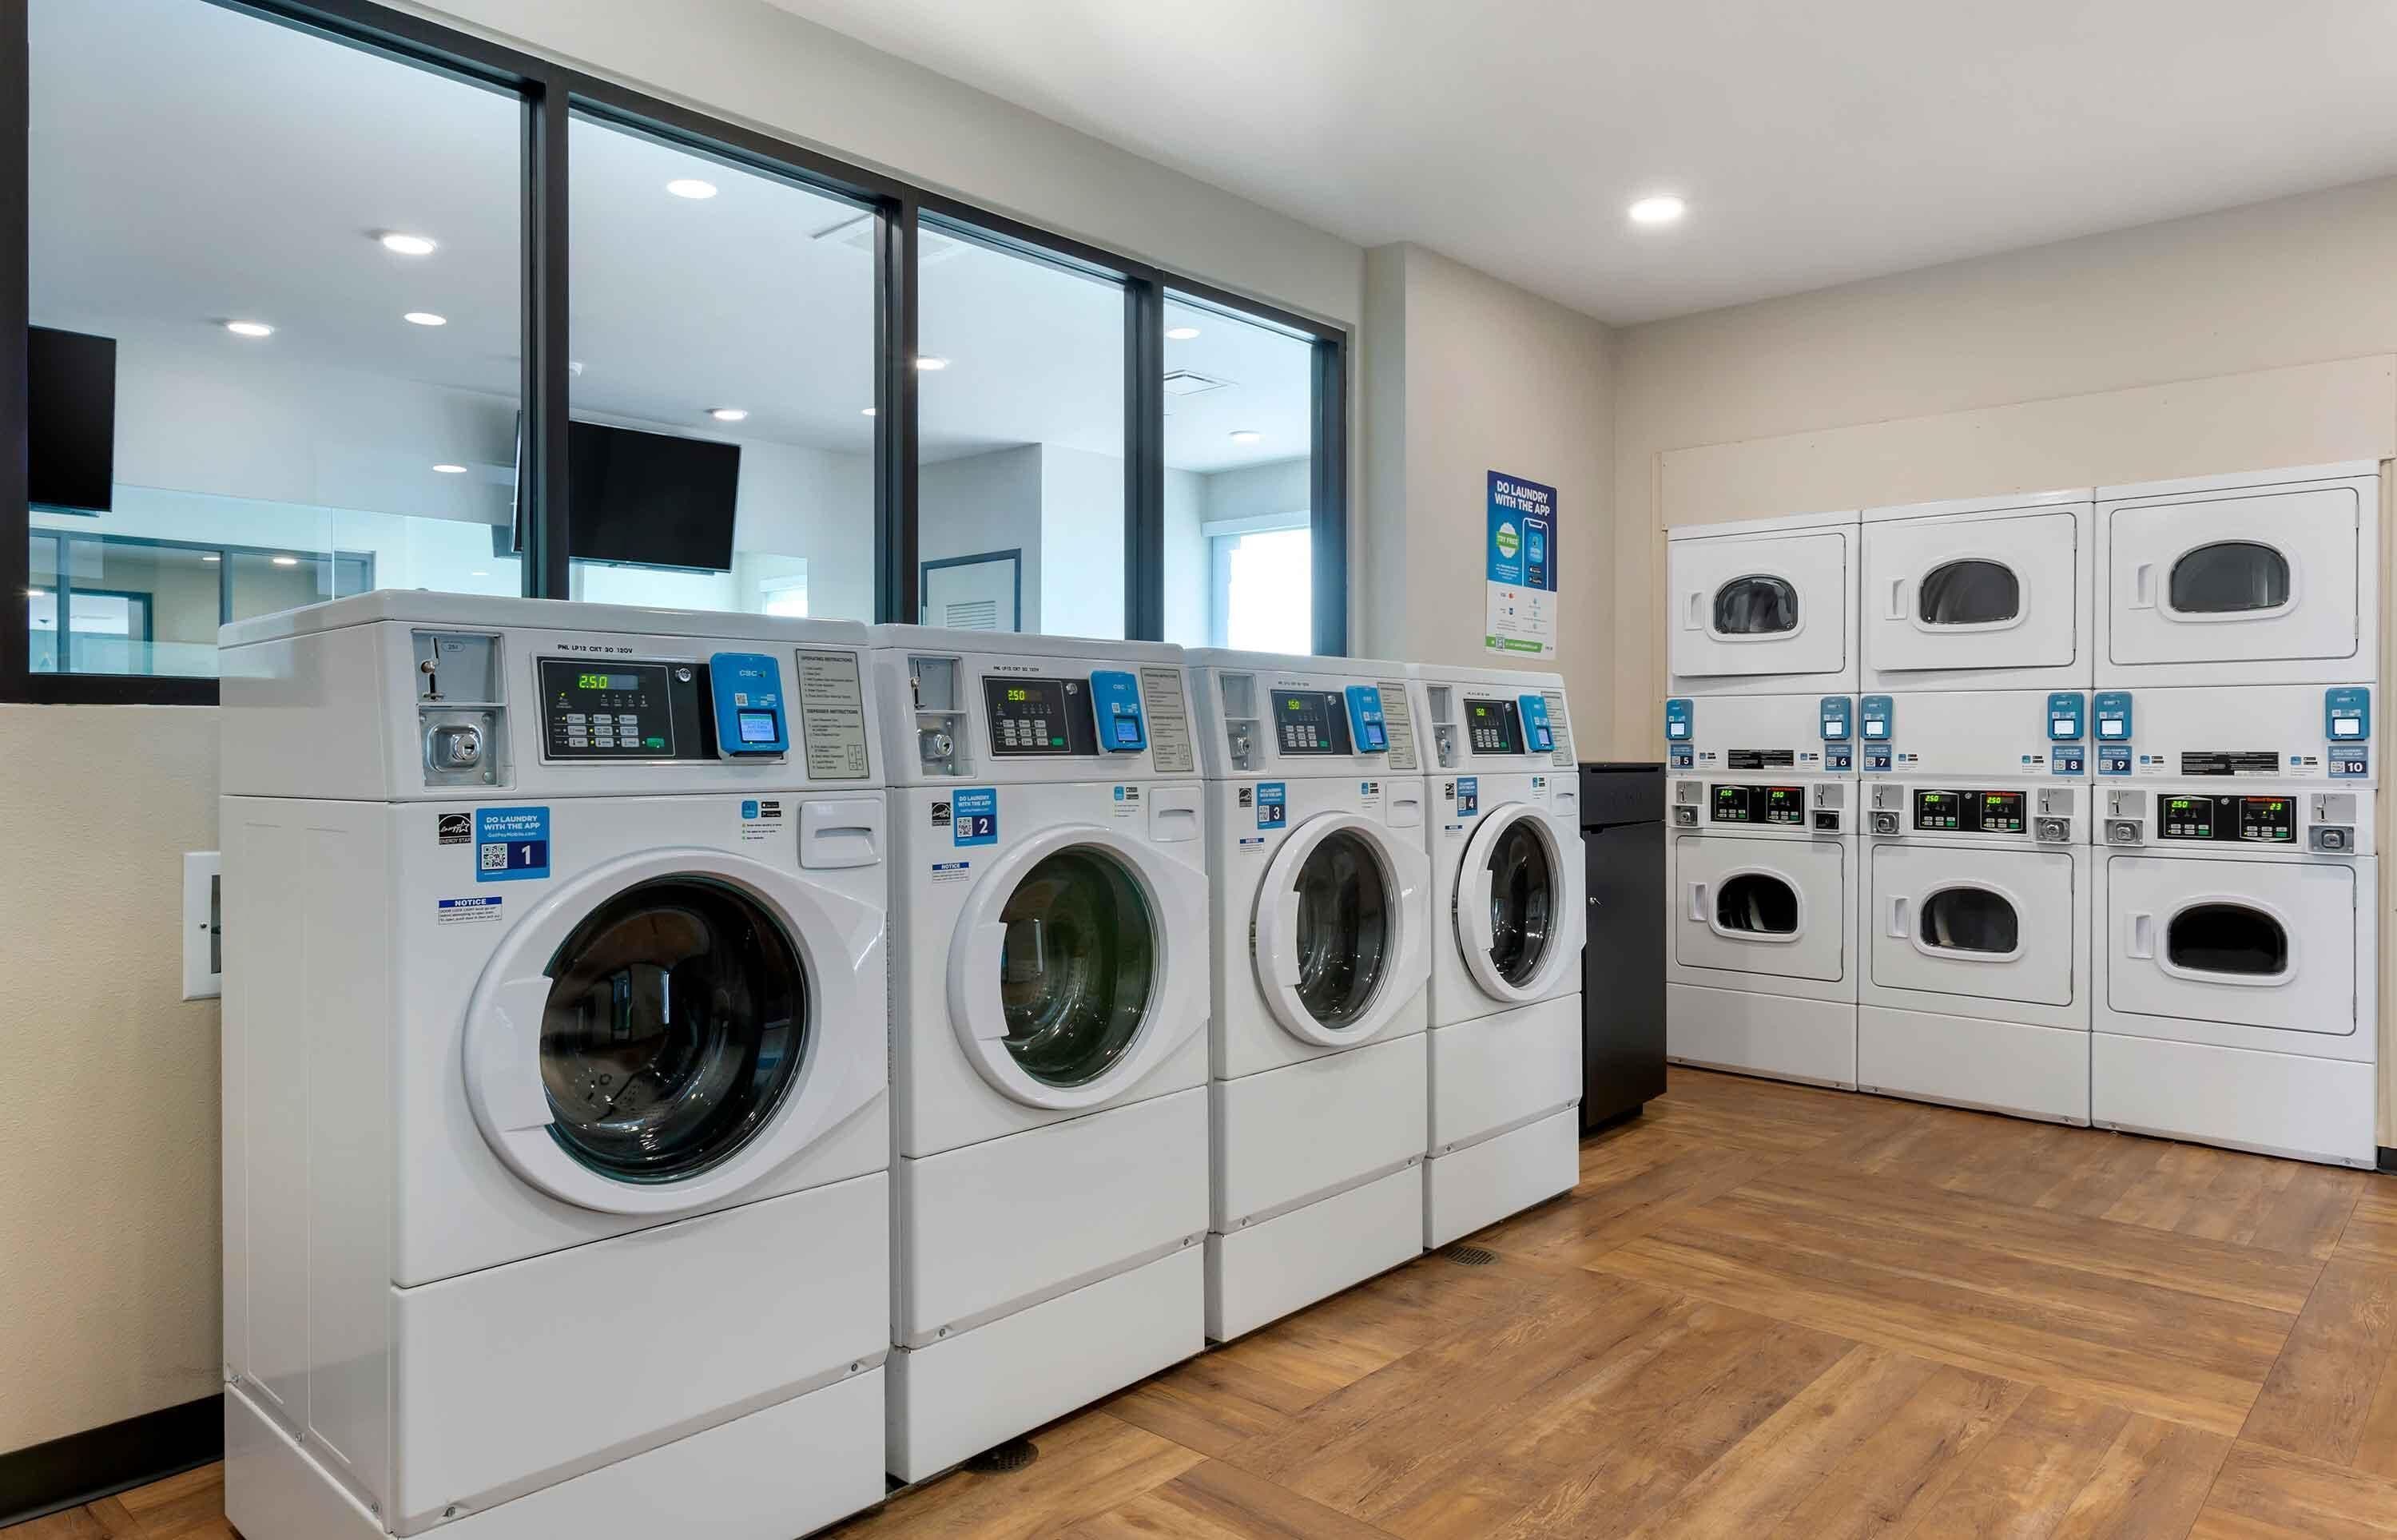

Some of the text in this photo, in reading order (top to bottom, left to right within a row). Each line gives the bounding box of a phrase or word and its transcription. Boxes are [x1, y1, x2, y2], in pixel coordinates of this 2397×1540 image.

[1497, 480, 1548, 503] DO LAUNDRY
[1495, 492, 1550, 517] WITH THE APP
[2070, 760, 2077, 769] 8
[2117, 760, 2125, 769] 9
[2347, 762, 2363, 772] 10
[1469, 797, 1474, 808] 4
[1273, 807, 1280, 820] 3
[979, 818, 988, 834] 2
[522, 845, 531, 865] 1
[455, 898, 487, 907] NOTICE
